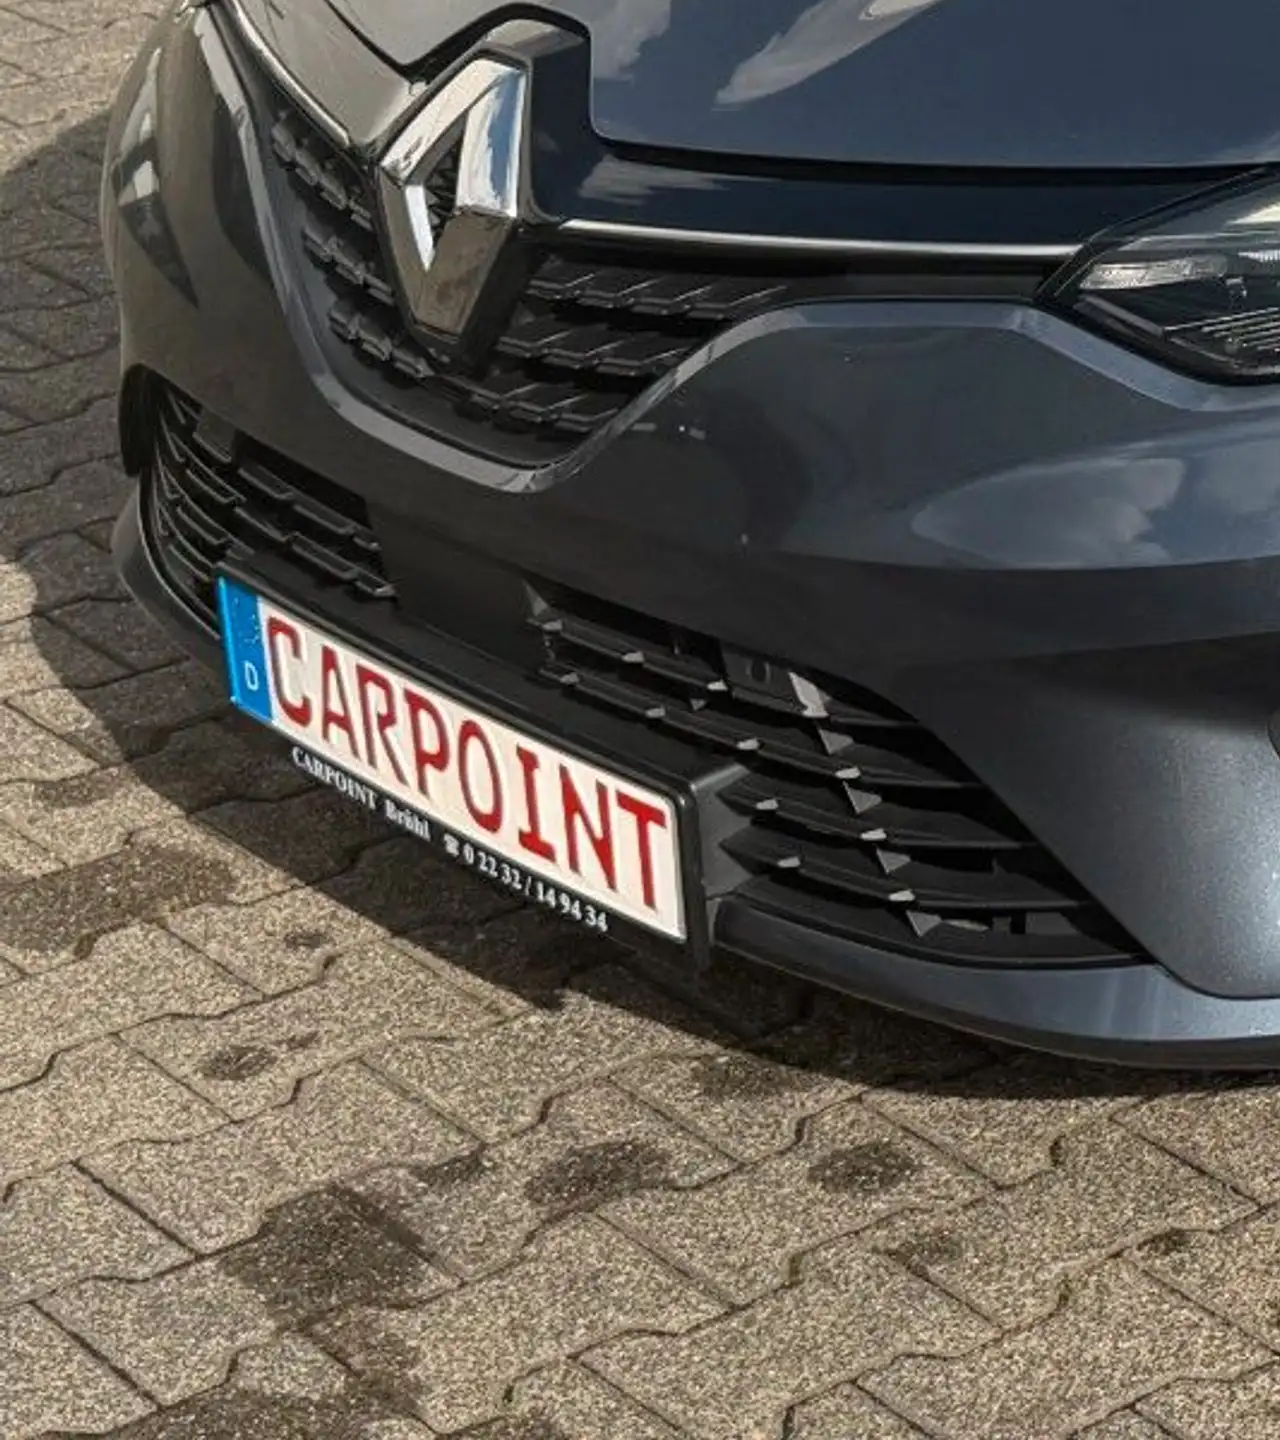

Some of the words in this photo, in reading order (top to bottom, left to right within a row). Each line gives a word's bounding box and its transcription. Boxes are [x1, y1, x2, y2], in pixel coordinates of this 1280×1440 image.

[243, 660, 259, 692] D
[267, 615, 667, 912] CARPOINT
[291, 746, 378, 810] CARPOINT
